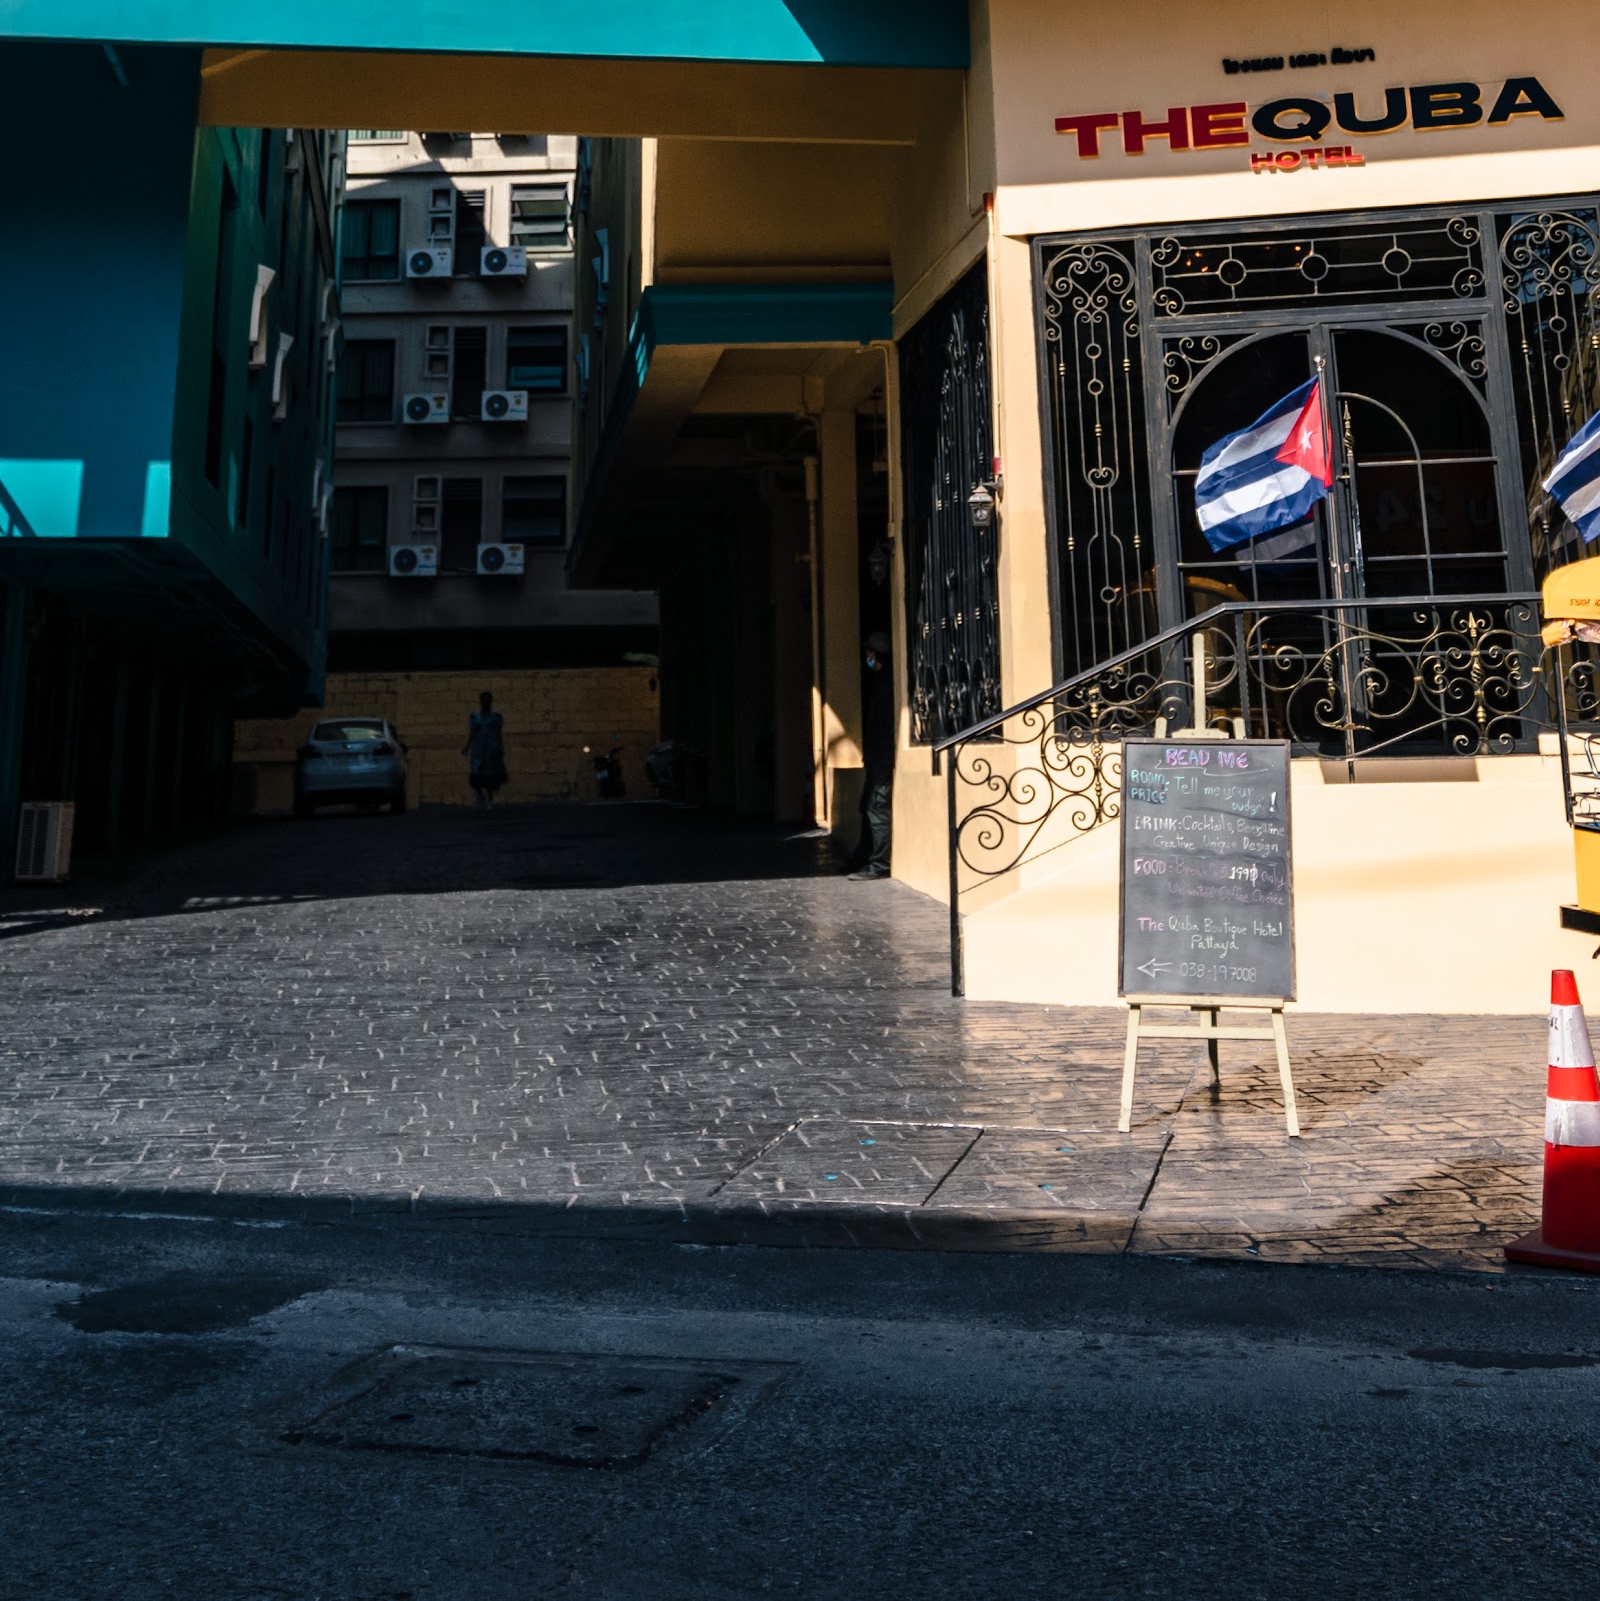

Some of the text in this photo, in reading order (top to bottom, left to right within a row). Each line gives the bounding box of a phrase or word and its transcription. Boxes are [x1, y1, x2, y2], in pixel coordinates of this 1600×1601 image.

[1251, 145, 1366, 171] HOTEL
[1218, 750, 1249, 770] ME
[1131, 787, 1167, 804] PRICE
[1173, 776, 1199, 795] Tell
[1204, 784, 1220, 797] me
[1243, 836, 1280, 858] Design
[1136, 916, 1165, 933] The
[1168, 914, 1200, 932] Quba
[1253, 919, 1283, 937] Hotel
[1190, 934, 1240, 959] Pattaya
